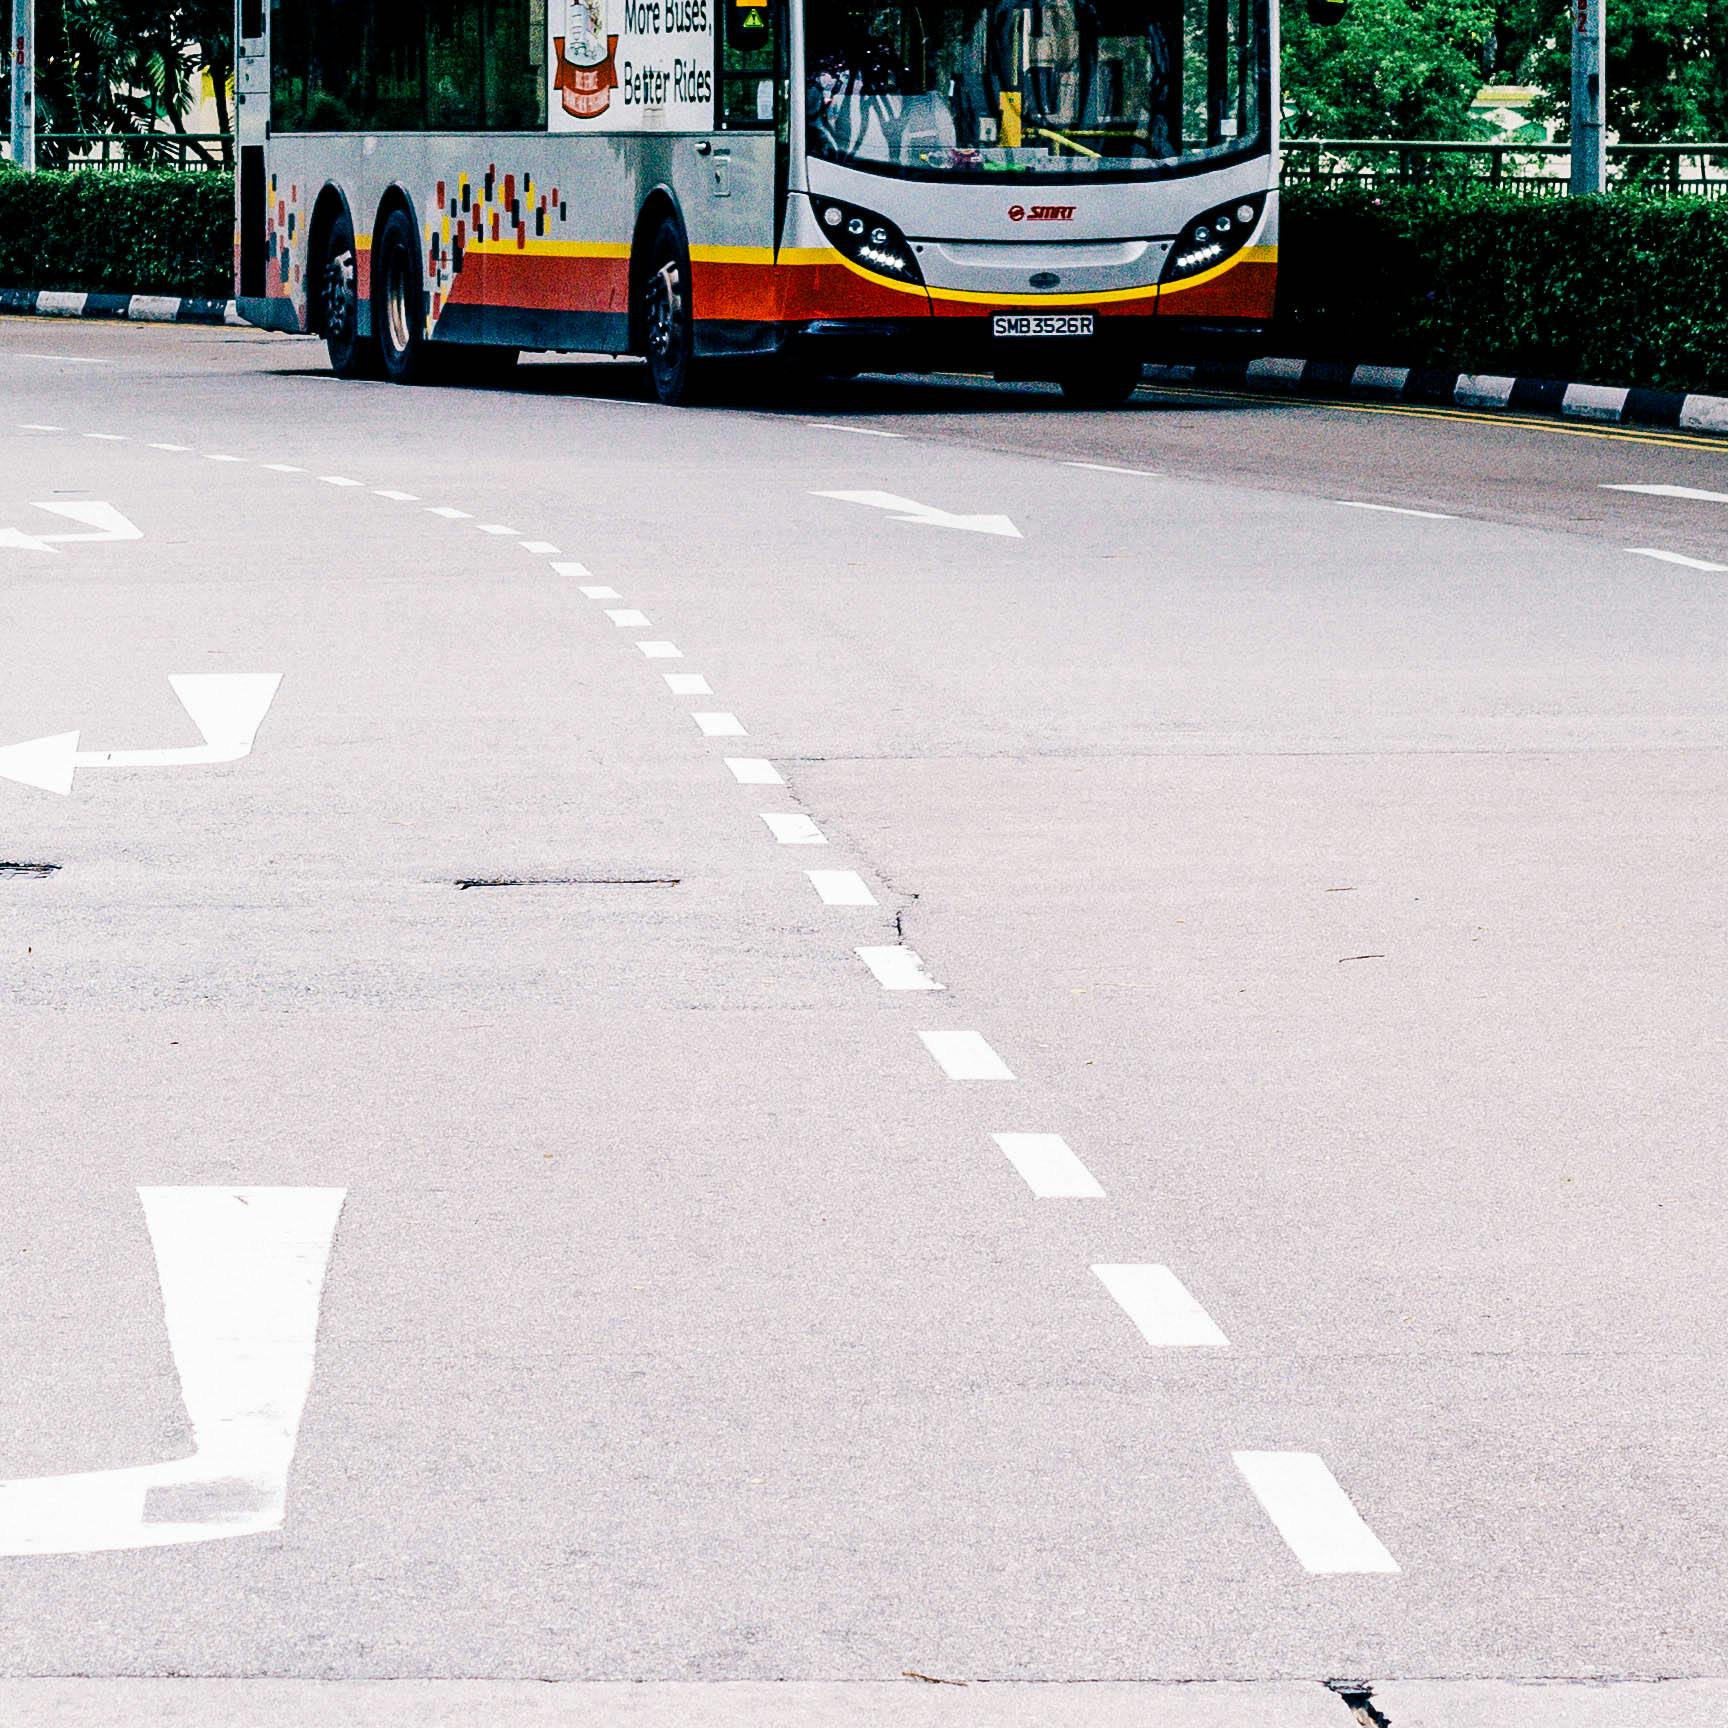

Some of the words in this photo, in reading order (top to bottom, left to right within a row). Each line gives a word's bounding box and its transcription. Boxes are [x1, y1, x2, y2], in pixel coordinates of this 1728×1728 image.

[624, 61, 671, 105] Better
[674, 58, 712, 104] Rides
[1027, 206, 1077, 219] SMRT
[995, 317, 1093, 334] SMB3526R
